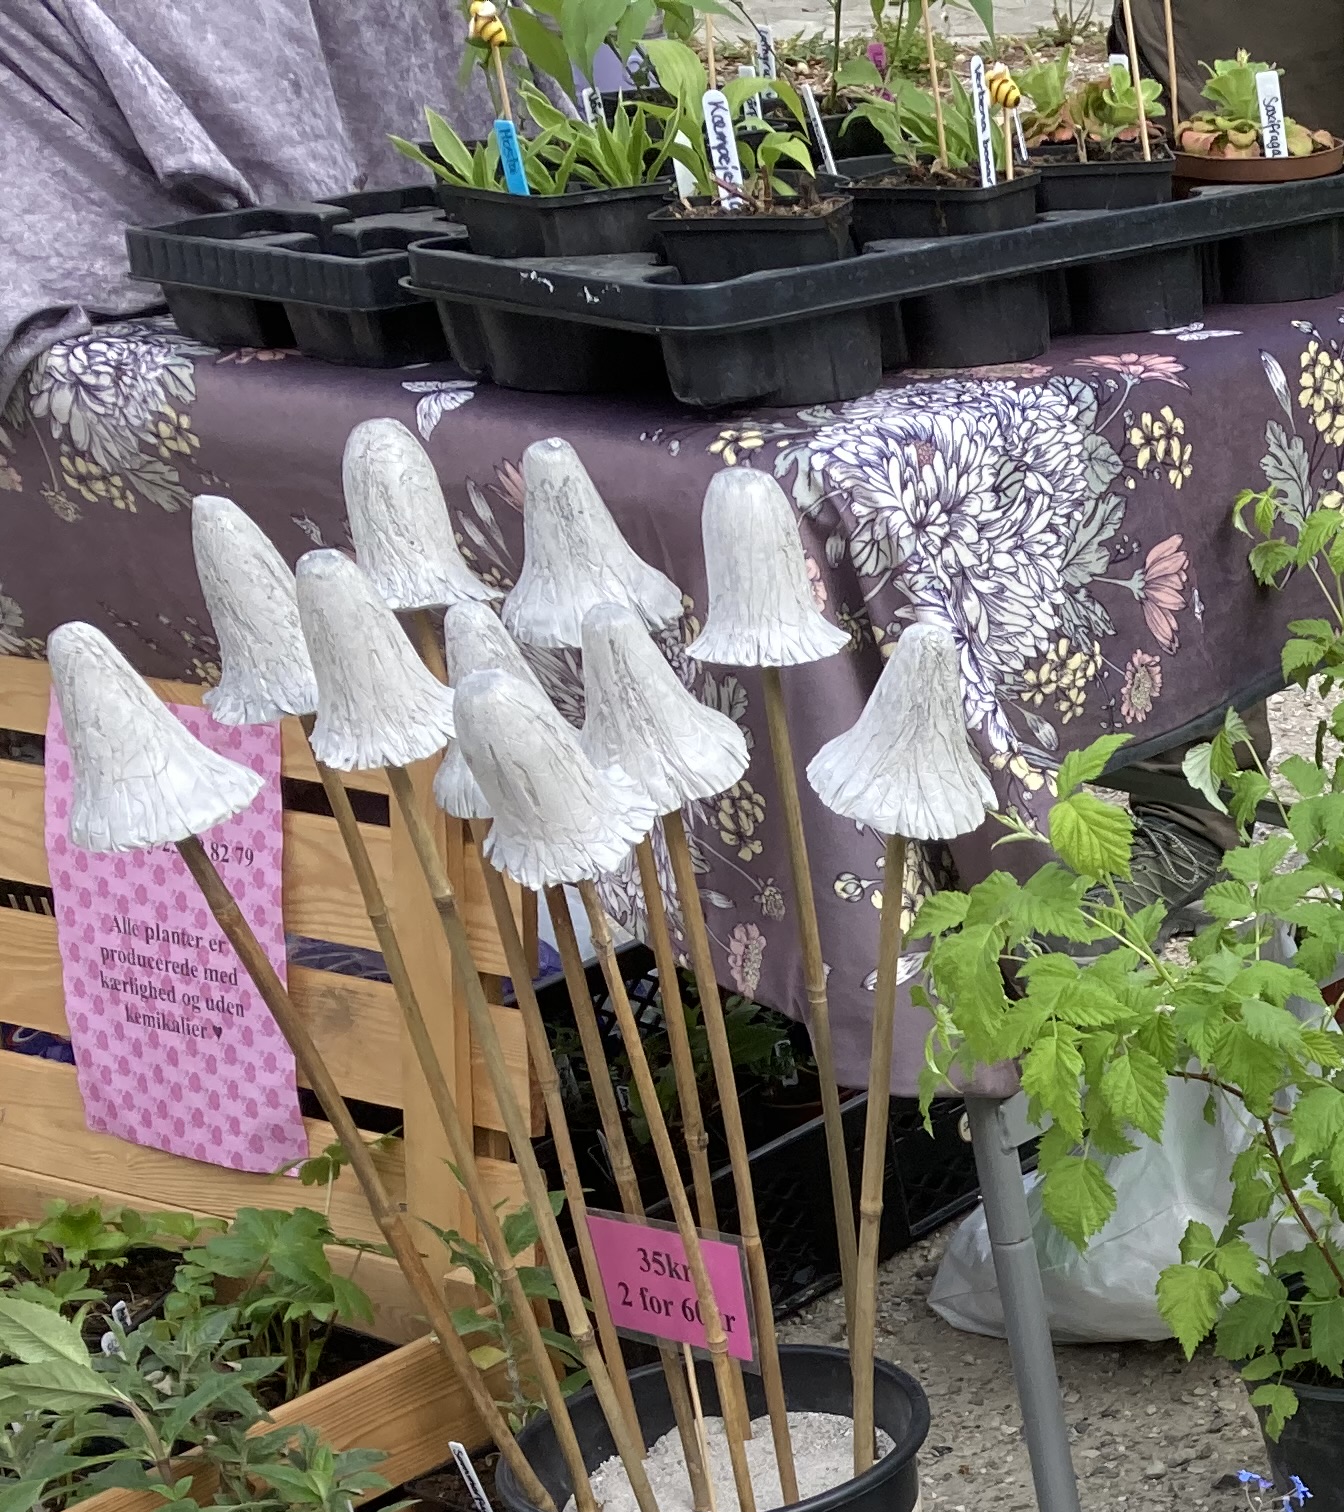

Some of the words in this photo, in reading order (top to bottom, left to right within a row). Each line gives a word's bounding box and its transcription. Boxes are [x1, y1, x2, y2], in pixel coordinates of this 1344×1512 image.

[1262, 96, 1287, 157] Saxifraga
[499, 128, 518, 174] Hosta
[210, 842, 229, 863] 82
[235, 846, 254, 866] 79
[111, 915, 138, 936] Alle
[145, 923, 203, 948] planter
[208, 940, 226, 953] er
[100, 945, 198, 978] producerede
[203, 966, 238, 986] med
[100, 970, 176, 1003] kærlighed
[181, 991, 201, 1013] og
[205, 995, 244, 1017] uden
[124, 1001, 208, 1038] kemikalier
[637, 1247, 691, 1282] 35kr
[618, 1282, 632, 1307] 2
[639, 1287, 674, 1317] for
[681, 1298, 736, 1332] 60r
